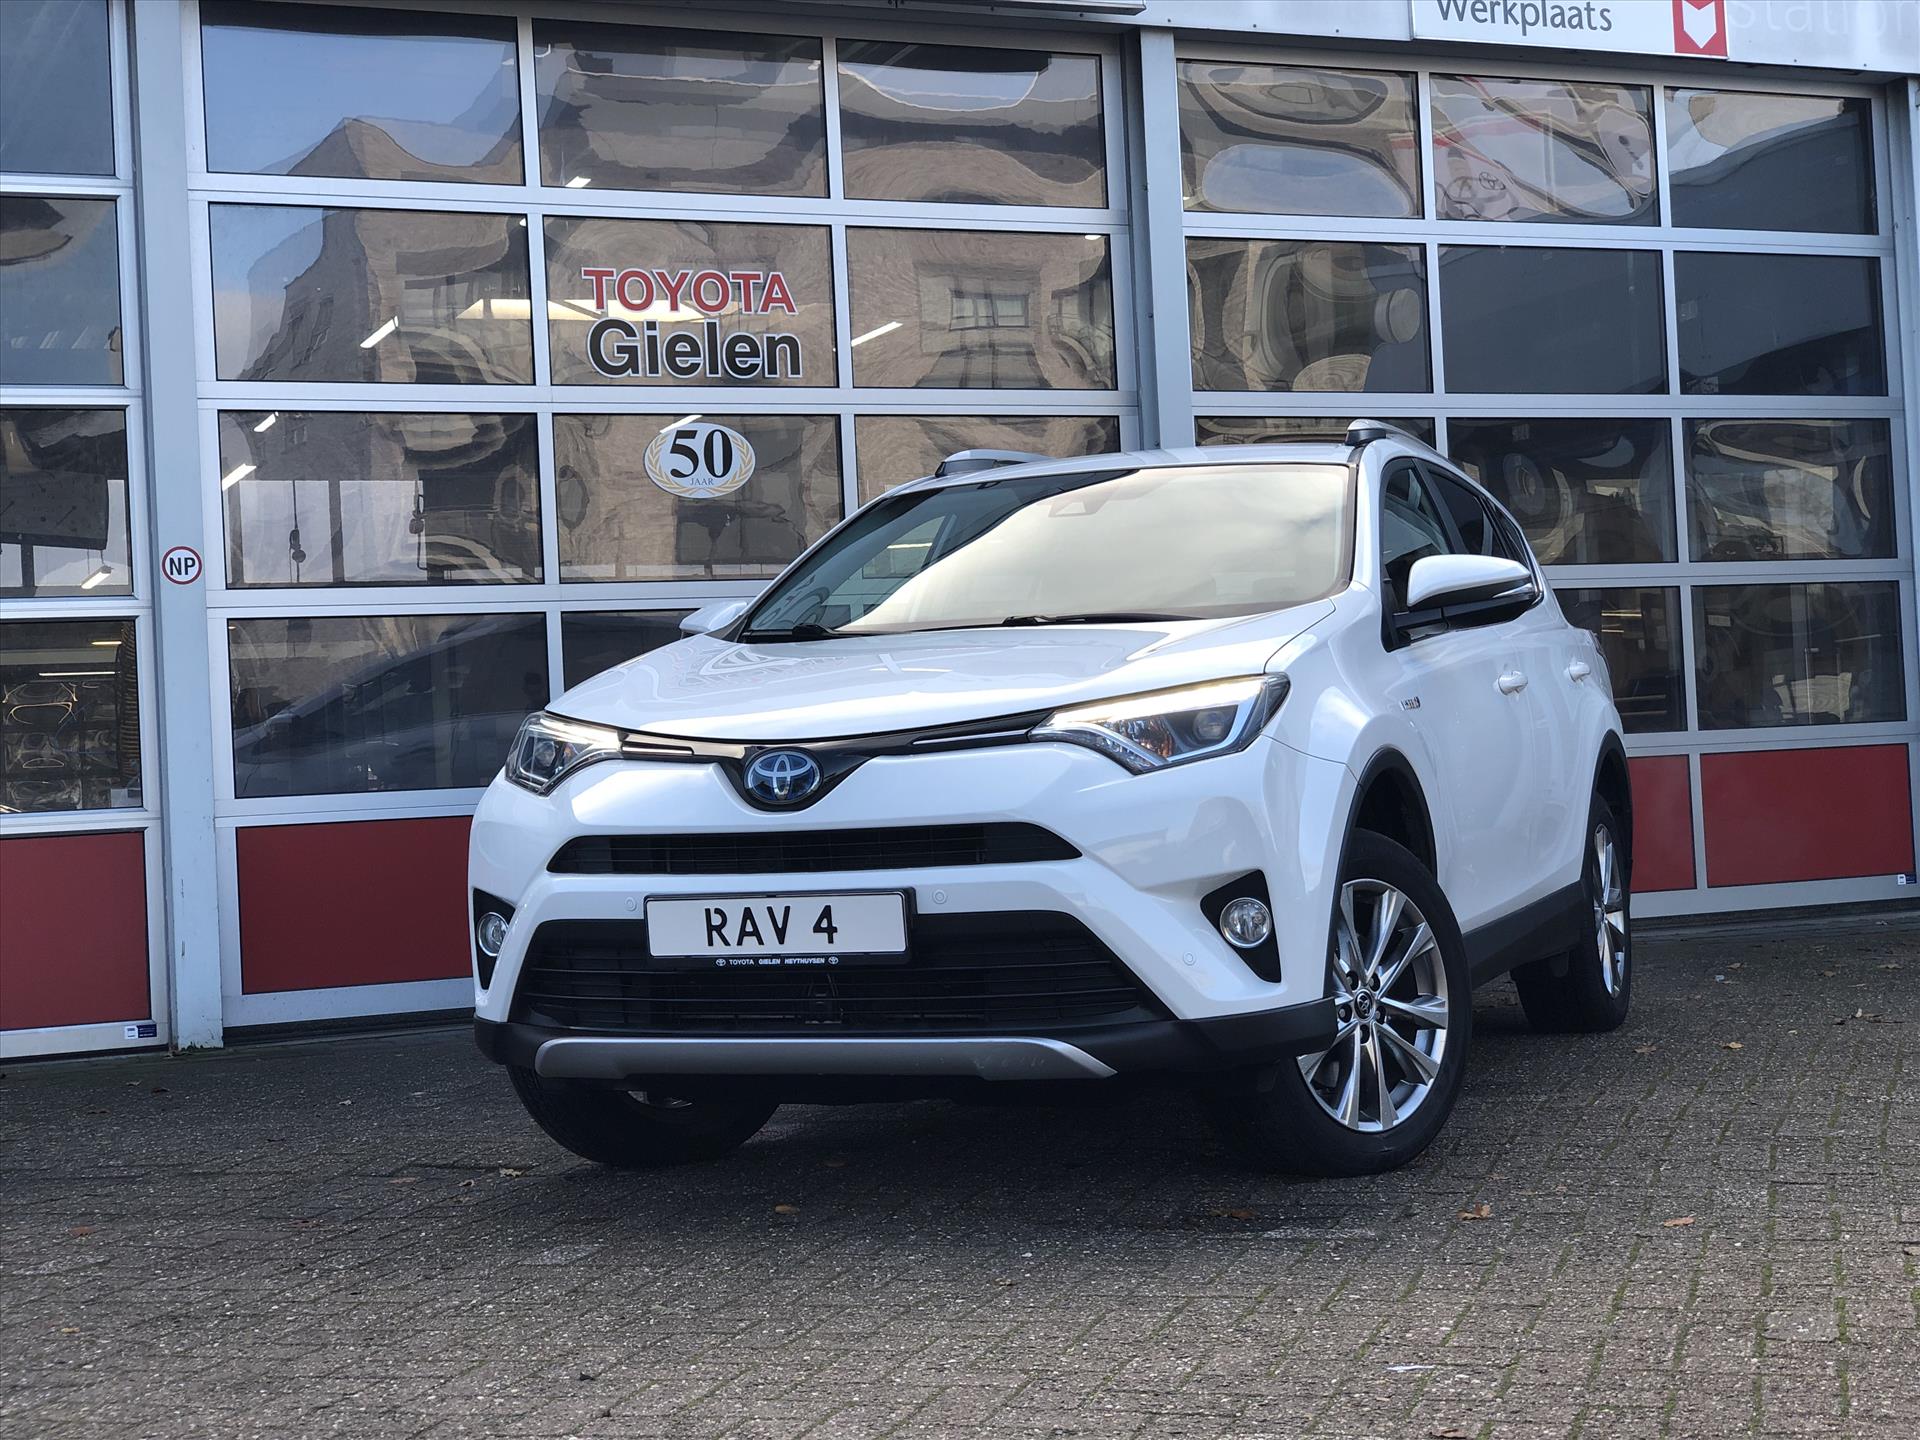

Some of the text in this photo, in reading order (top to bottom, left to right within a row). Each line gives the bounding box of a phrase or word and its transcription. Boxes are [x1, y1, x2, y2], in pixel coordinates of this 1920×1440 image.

[1437, 0, 1612, 36] Werkplaats
[582, 267, 798, 314] TOYOTA
[588, 318, 802, 378] Gielen
[670, 429, 733, 478] 50
[690, 477, 714, 486] JAAR
[169, 557, 196, 576] NP
[705, 905, 838, 947] RAV 4
